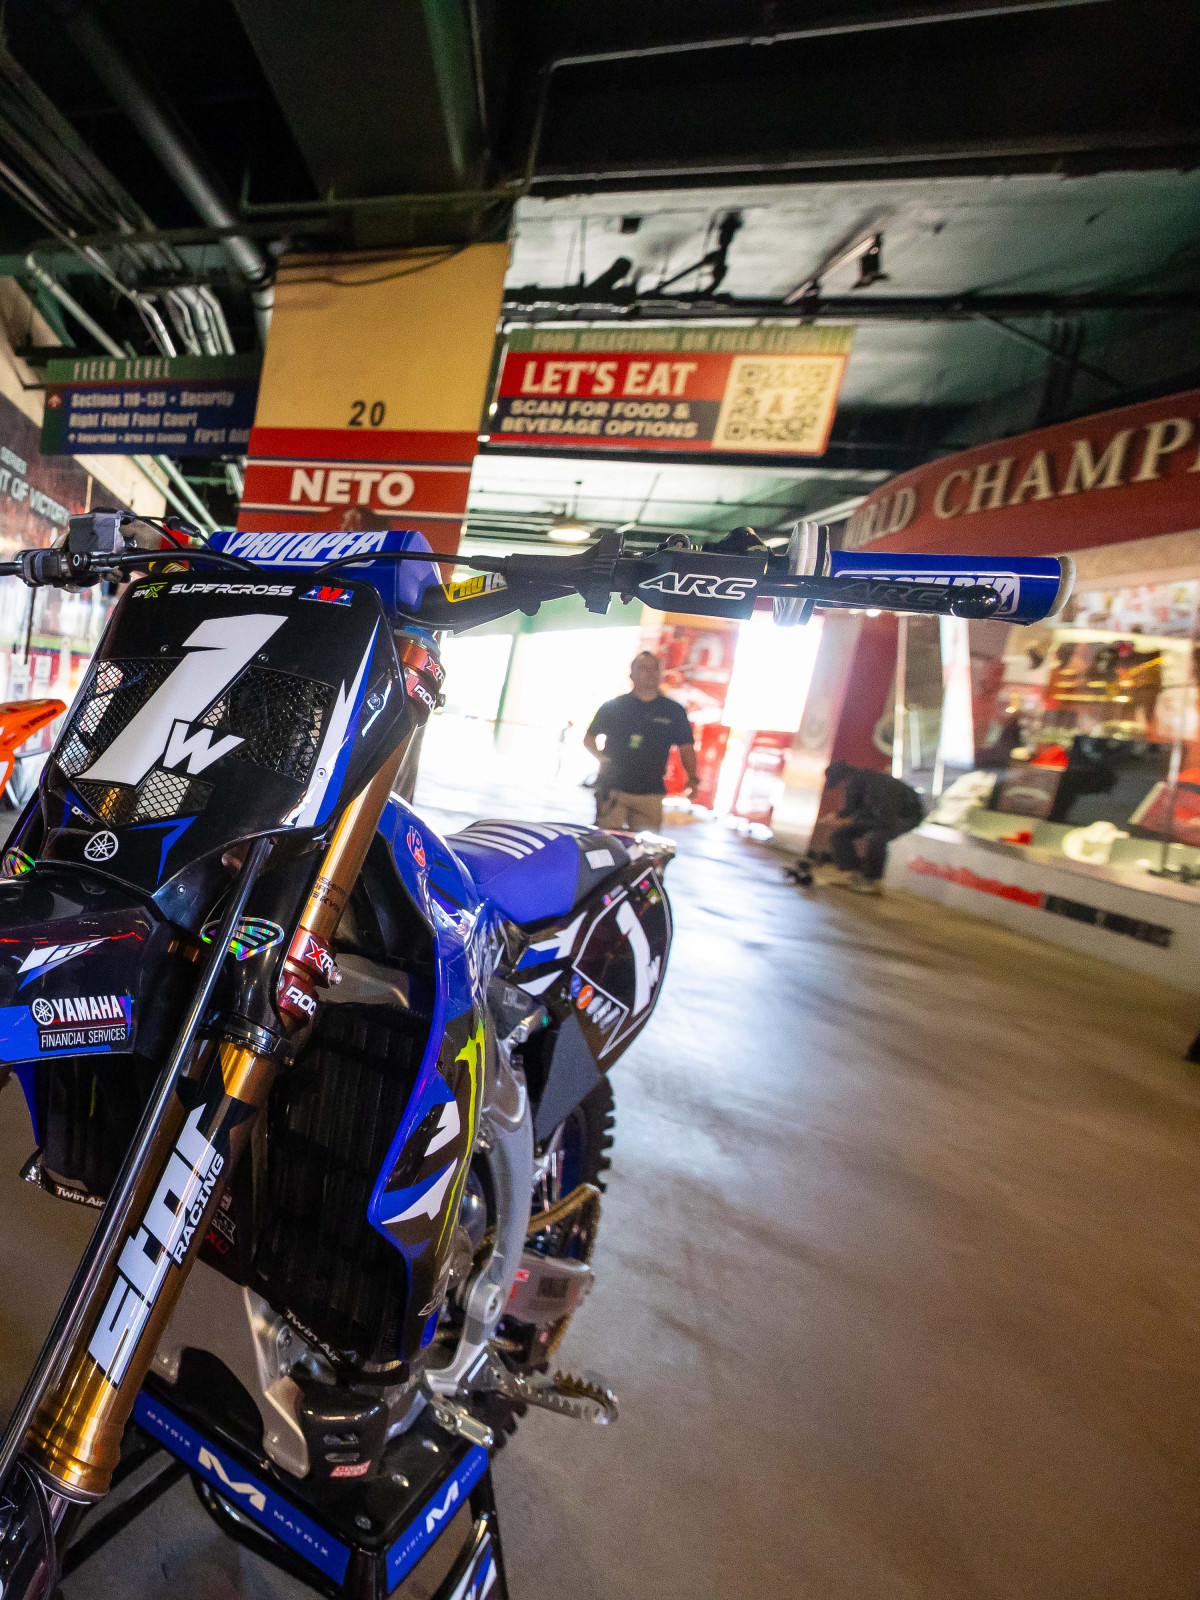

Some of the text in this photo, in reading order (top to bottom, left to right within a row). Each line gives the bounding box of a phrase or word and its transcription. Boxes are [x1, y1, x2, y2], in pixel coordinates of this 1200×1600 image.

[521, 361, 697, 397] LET'S EAT
[350, 401, 386, 428] 20
[511, 400, 690, 420] SCAN FOR FOOD &
[501, 418, 698, 439] BEVERAGE OPTIONS
[933, 417, 1200, 520] CHAMP
[11, 476, 29, 502] OF
[30, 487, 71, 527] VICTORY
[289, 468, 415, 507] NETO
[168, 583, 296, 597] SUPERCROSS
[639, 572, 757, 600] ARC
[74, 613, 289, 787] 1
[51, 995, 124, 1023] YAMAHA
[41, 1027, 126, 1049] FINANCIAL SERVICES
[55, 1185, 106, 1209] Twin Air
[171, 1153, 225, 1265] RACING
[286, 1307, 341, 1363] Twin Air
[273, 1510, 329, 1557] MATRIX
